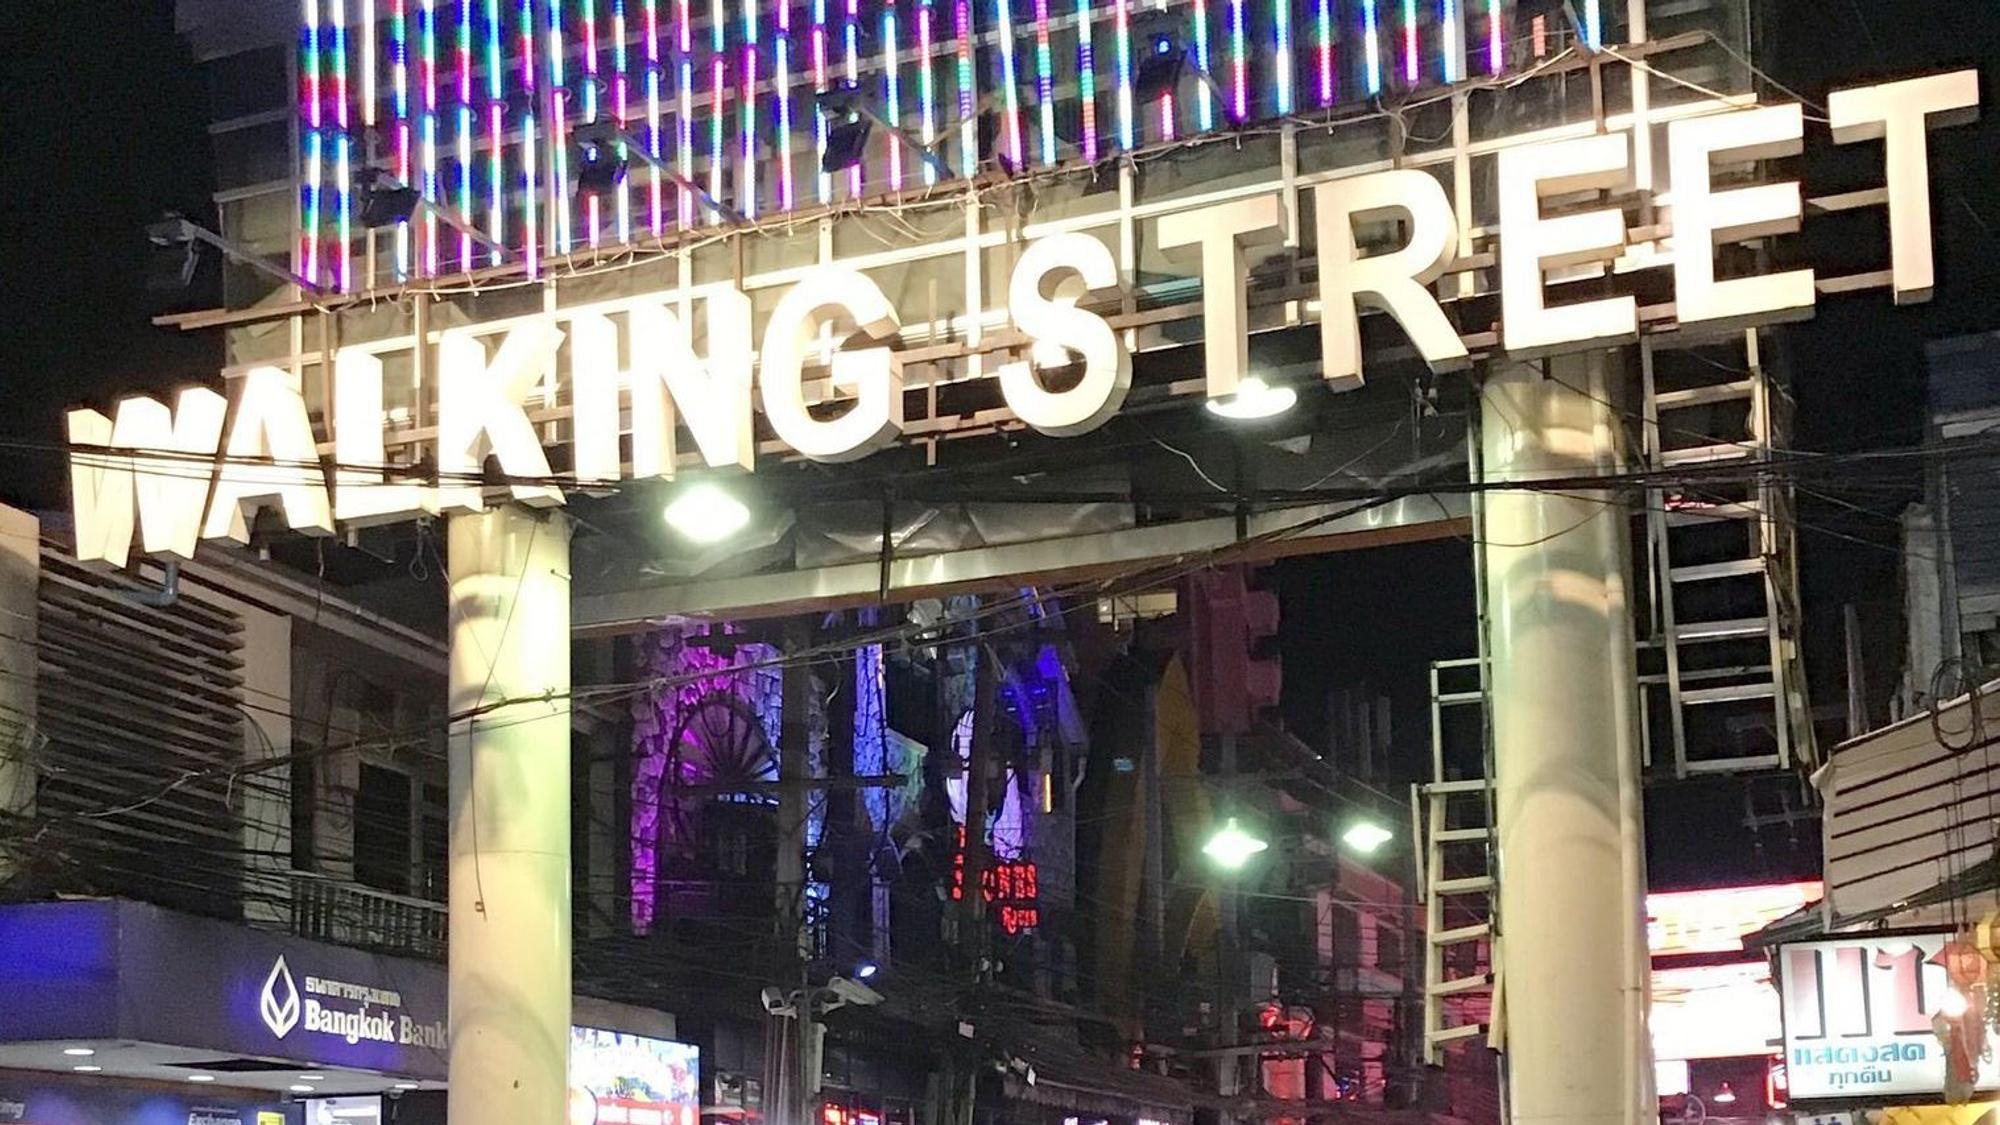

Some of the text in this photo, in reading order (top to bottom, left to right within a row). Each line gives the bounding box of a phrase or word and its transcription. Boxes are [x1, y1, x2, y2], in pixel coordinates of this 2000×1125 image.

[67, 69, 1980, 568] WALKING STREET
[304, 998, 448, 1049] Bangkok Bank
